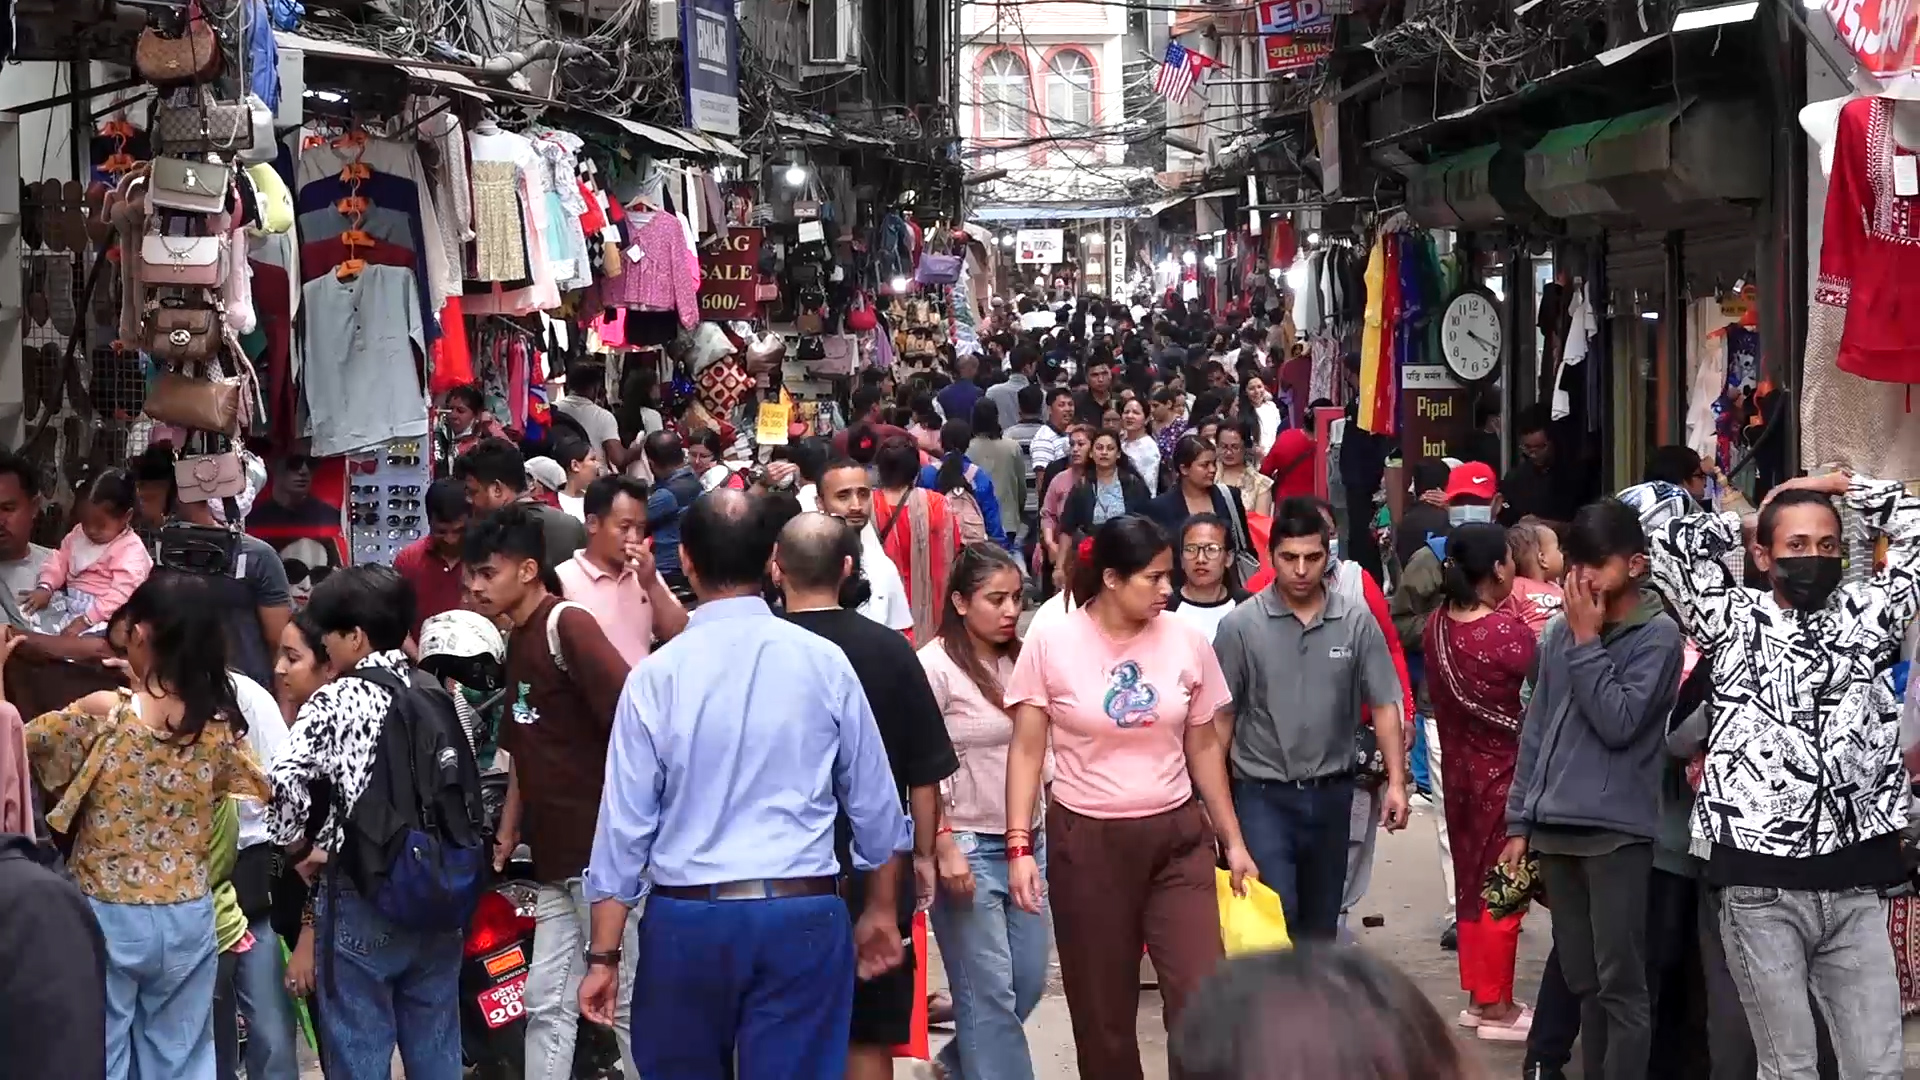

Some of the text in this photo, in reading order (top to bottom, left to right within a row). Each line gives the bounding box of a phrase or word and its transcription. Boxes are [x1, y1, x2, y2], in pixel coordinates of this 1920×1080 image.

[711, 235, 750, 254] AG
[1113, 220, 1124, 267] SALE
[700, 265, 753, 280] SALE
[702, 294, 746, 310] 600/-
[1469, 300, 1478, 311] 12
[1460, 304, 1467, 316] 11
[1482, 304, 1486, 315] 1
[1452, 316, 1460, 326] 10
[1489, 315, 1496, 327] 2
[1449, 331, 1457, 341] 9
[1492, 332, 1499, 341] 3
[1453, 346, 1459, 357] 8
[1461, 357, 1467, 369] 7
[1471, 362, 1479, 373] 6
[1482, 357, 1489, 369] 5
[1417, 396, 1453, 421] Pipal
[1423, 436, 1447, 456] bot
[496, 967, 527, 983] HONDA
